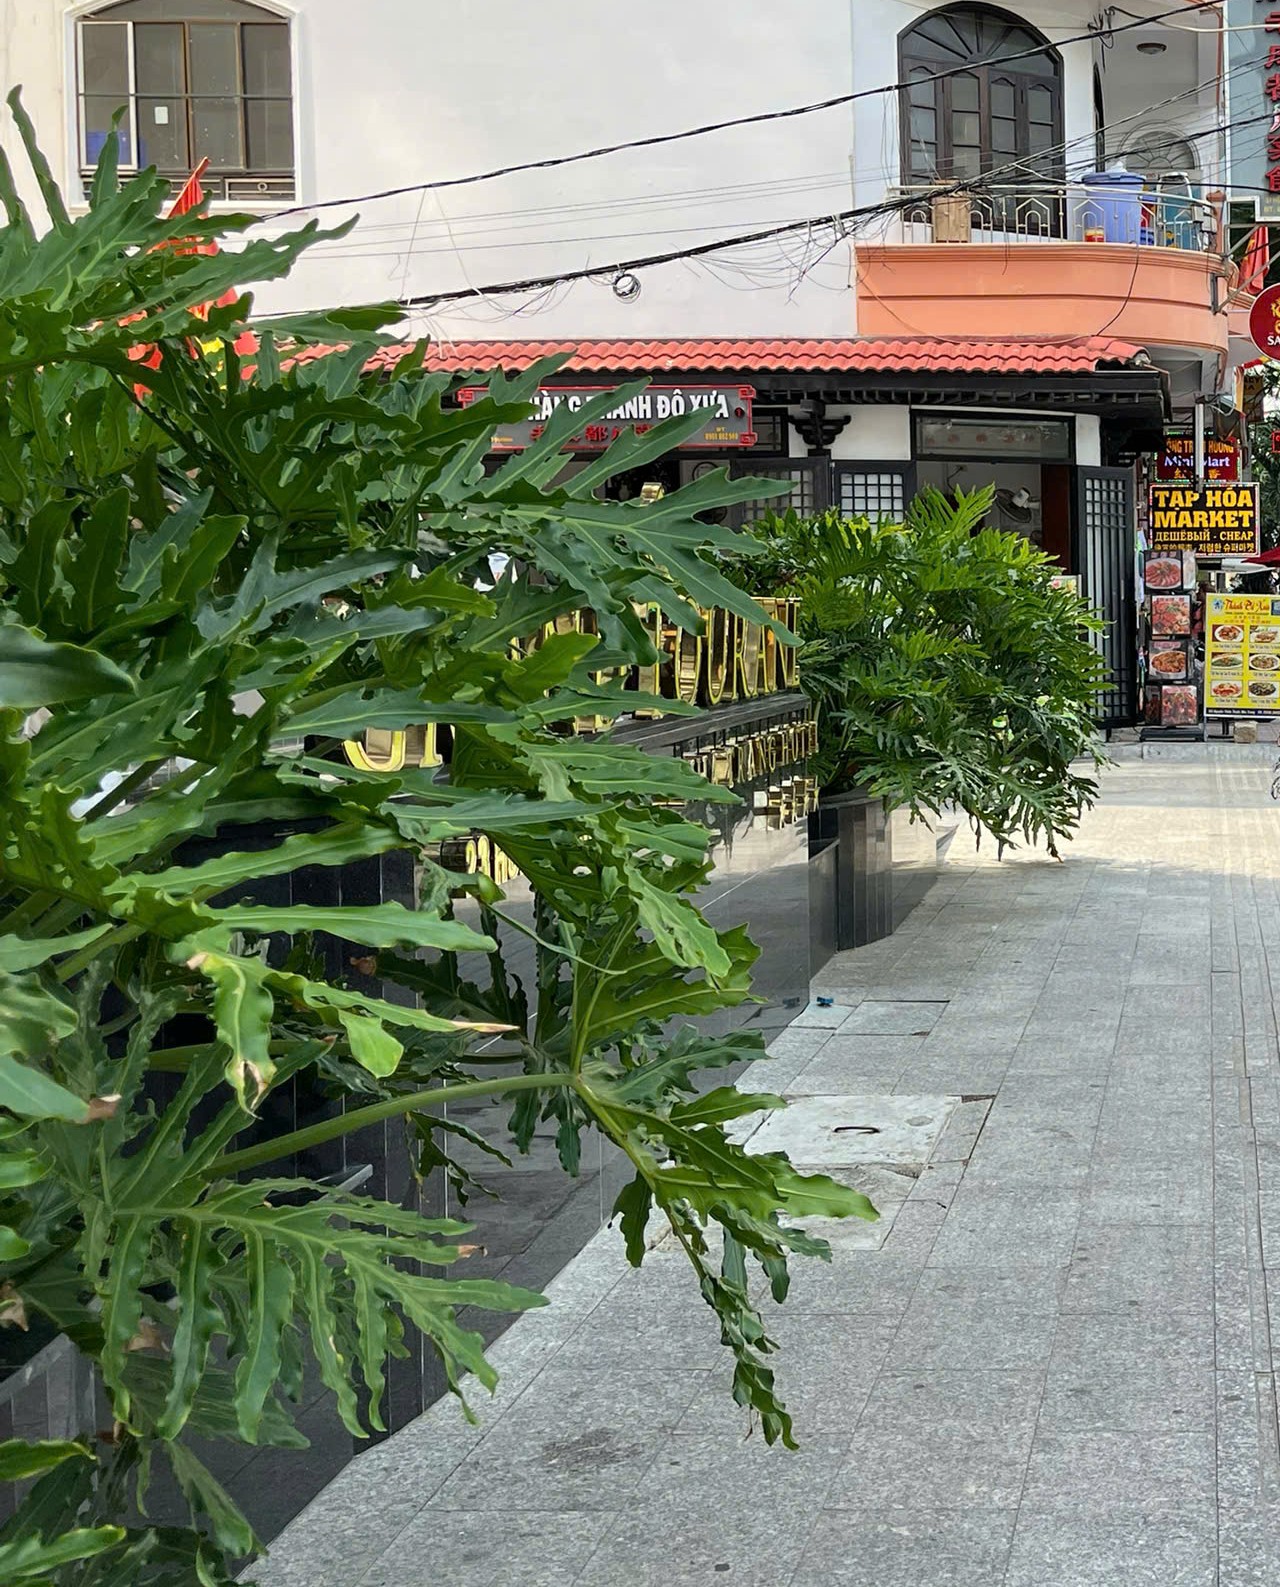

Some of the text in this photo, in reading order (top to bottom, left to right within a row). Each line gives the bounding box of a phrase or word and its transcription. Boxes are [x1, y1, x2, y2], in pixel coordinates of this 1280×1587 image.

[656, 388, 685, 419] ĐÔ
[1205, 486, 1254, 508] HÓA
[1153, 510, 1254, 528] MARKET
[1219, 531, 1254, 541] CHEAP
